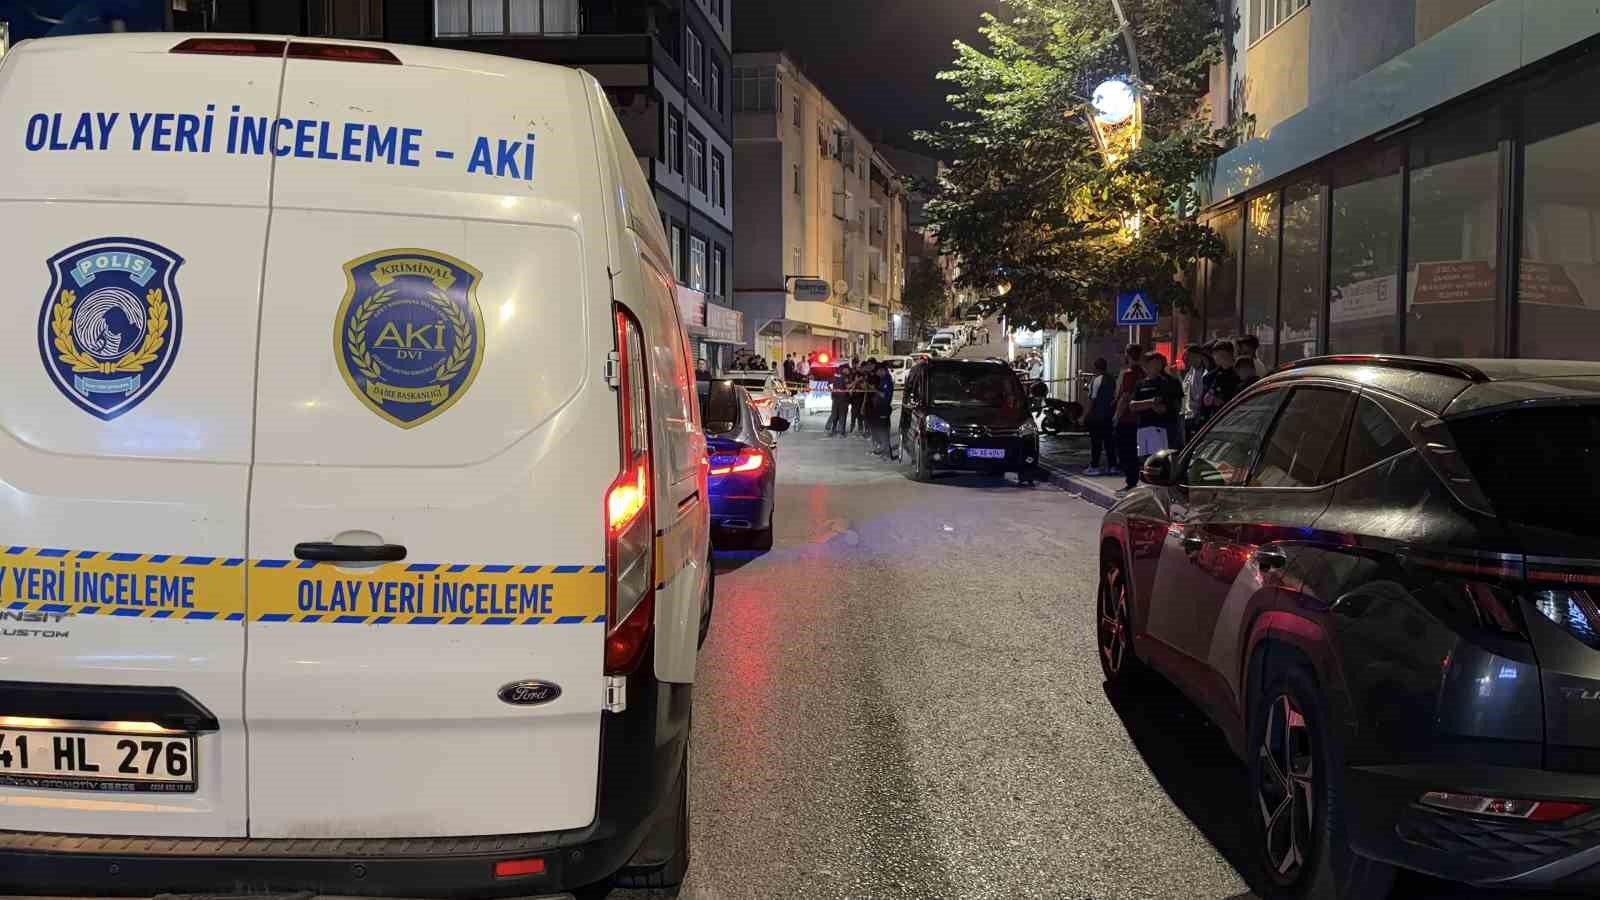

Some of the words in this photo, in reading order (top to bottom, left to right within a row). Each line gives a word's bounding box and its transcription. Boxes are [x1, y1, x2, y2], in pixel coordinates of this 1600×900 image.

[25, 112, 119, 151] OLAY
[129, 104, 215, 152] YERİ
[226, 105, 423, 167] İNCELEME
[467, 133, 535, 180] AKİ
[374, 320, 446, 350] AKİ
[397, 350, 423, 360] DVI
[12, 561, 65, 602] YERİ
[74, 562, 195, 608] İNCELEME
[298, 579, 362, 612] OLAY
[368, 574, 424, 614] YERİ
[433, 574, 554, 614] İNCELEME
[0, 610, 75, 623] NSIT
[0, 628, 70, 638] USTOM
[512, 686, 548, 701] Ford
[53, 736, 99, 772] HL
[117, 739, 187, 776] 276
